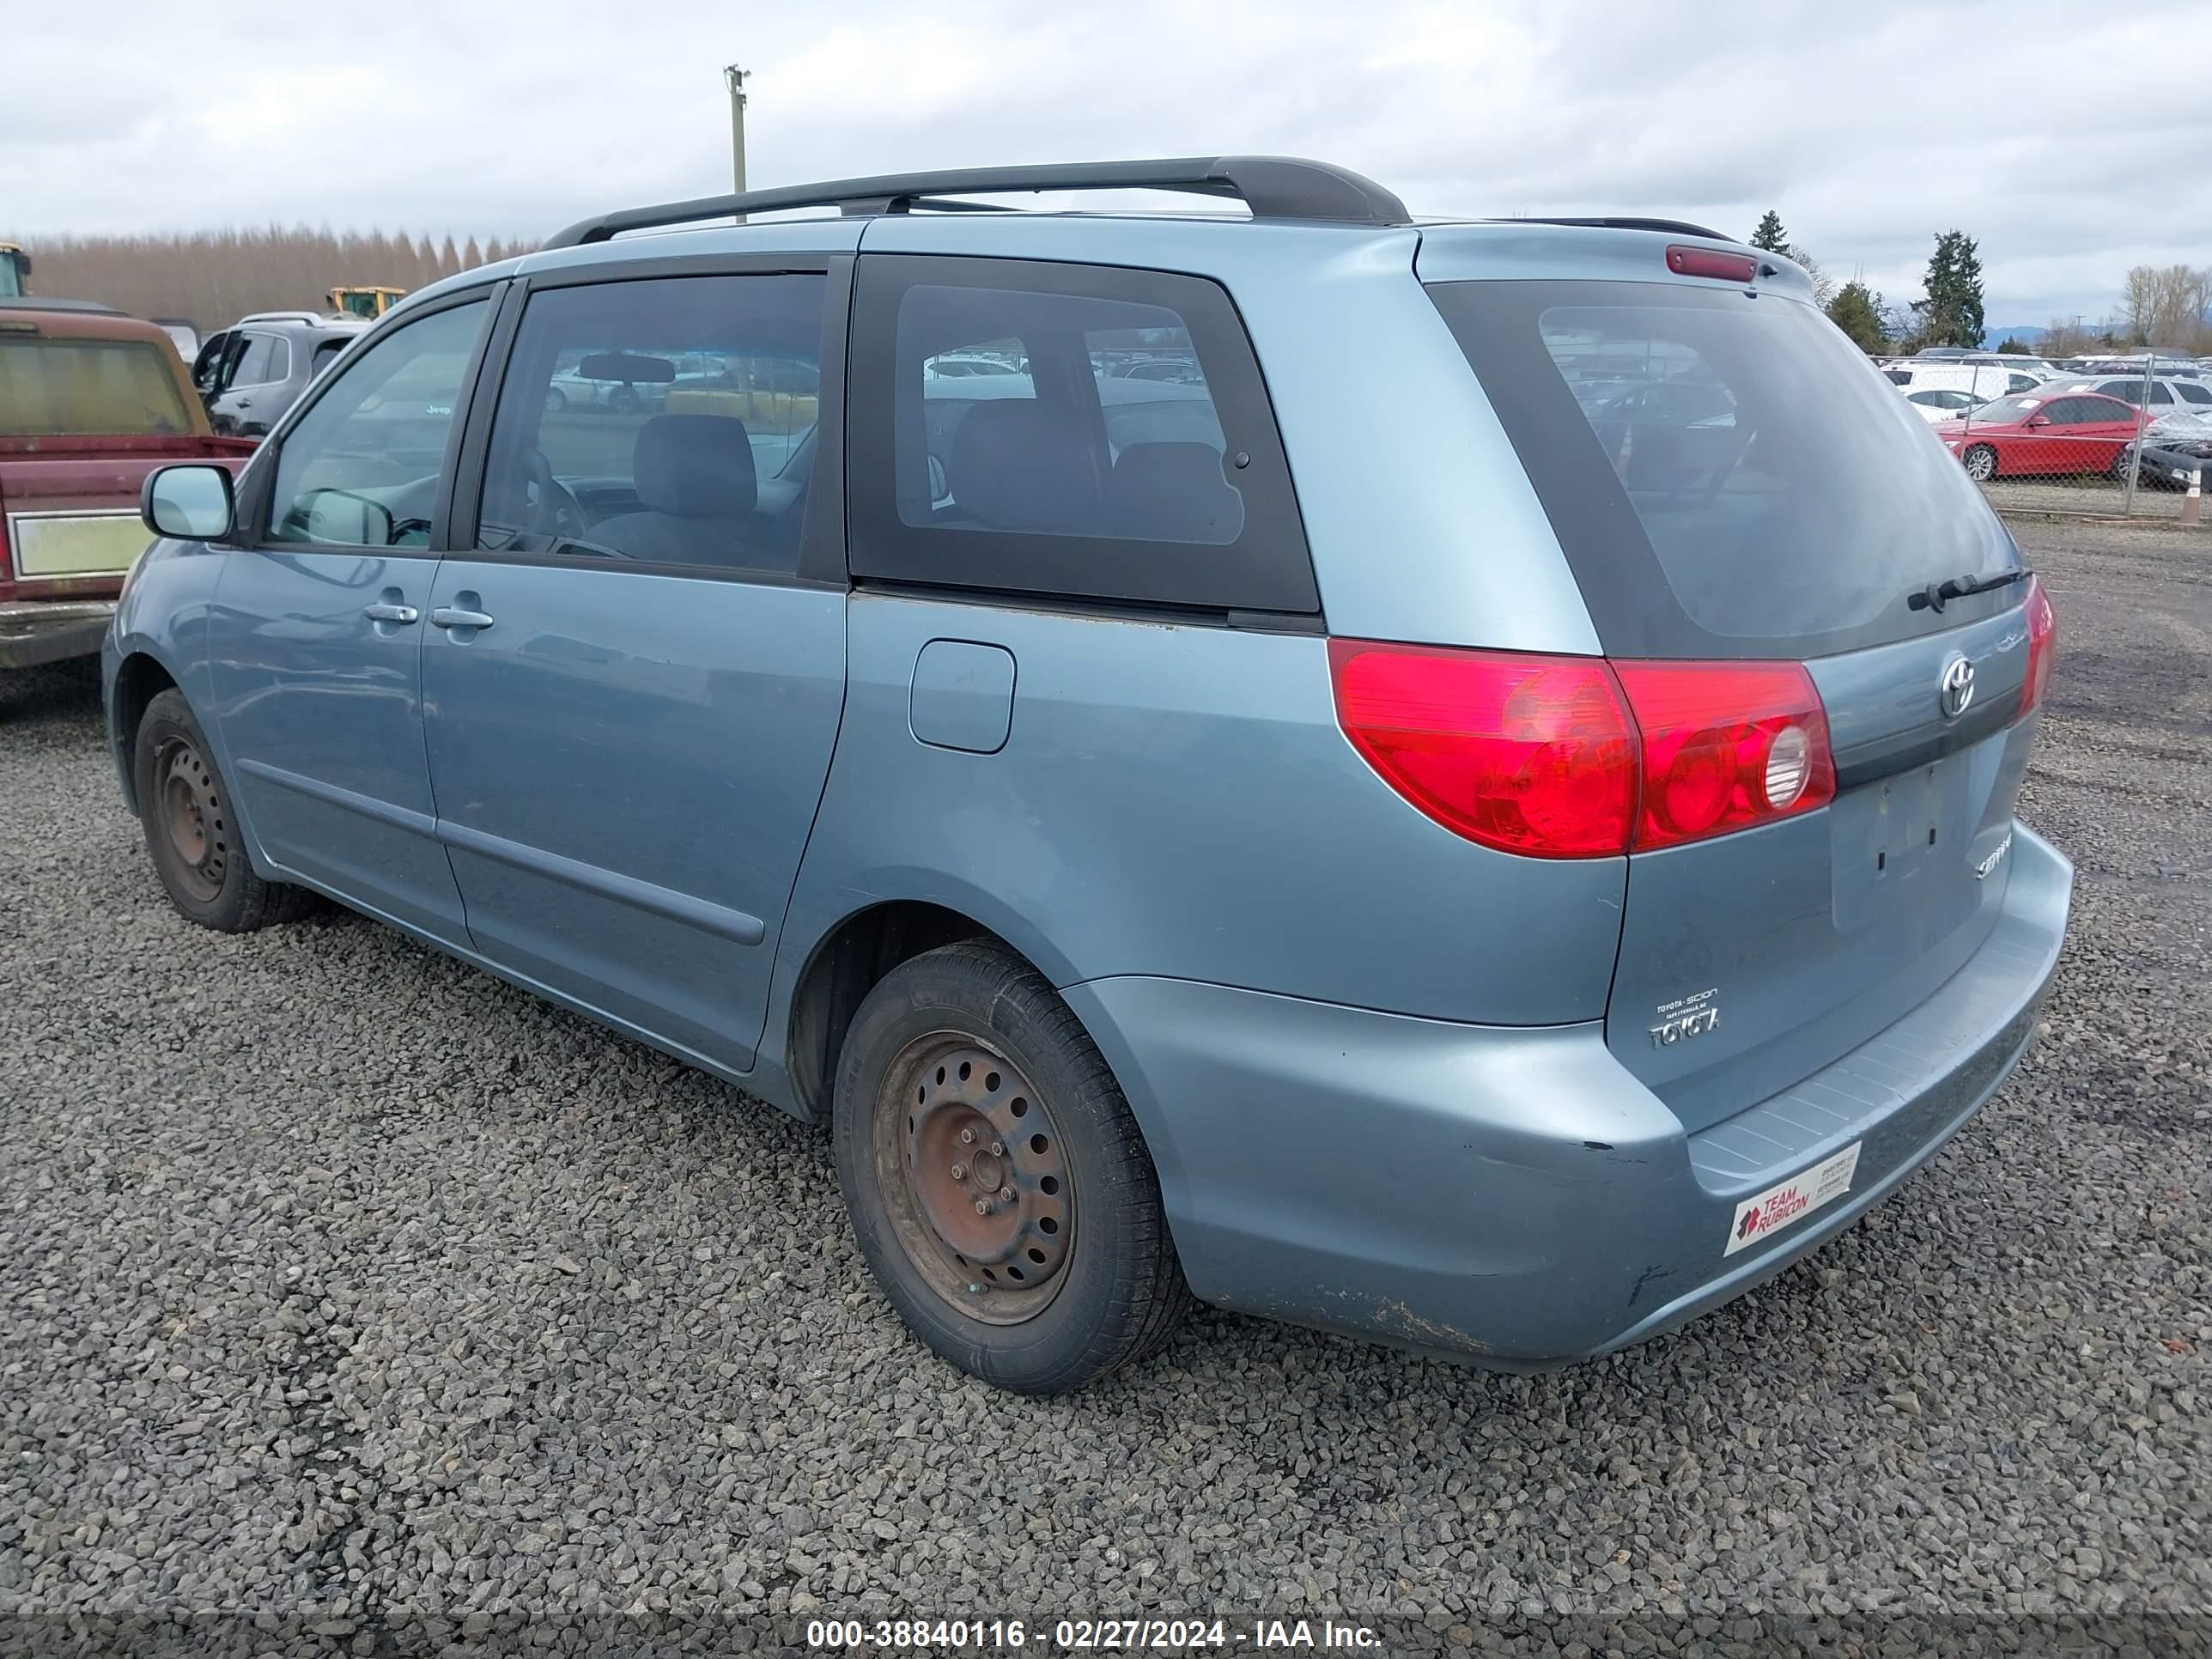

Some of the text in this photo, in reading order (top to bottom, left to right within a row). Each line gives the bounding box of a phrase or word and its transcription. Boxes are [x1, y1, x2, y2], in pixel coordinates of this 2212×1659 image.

[1656, 1000, 1682, 1014] TOYOTA
[1649, 1007, 1720, 1051] TOYOTA
[1757, 1193, 1810, 1233] RUBICON
[1764, 1185, 1797, 1215] TEAM
